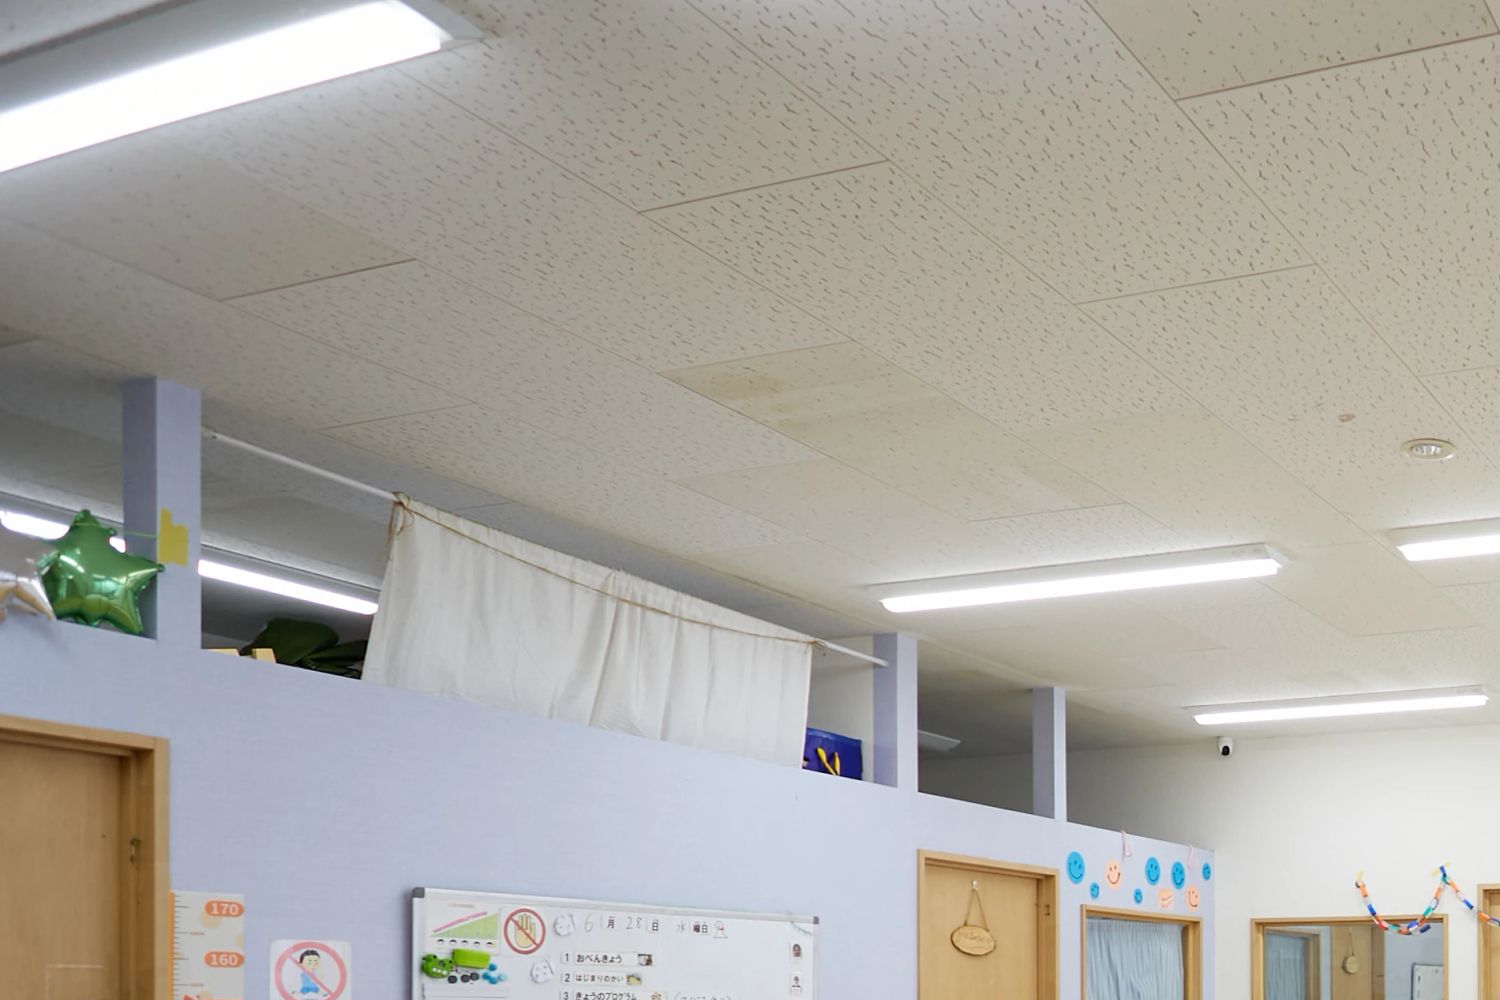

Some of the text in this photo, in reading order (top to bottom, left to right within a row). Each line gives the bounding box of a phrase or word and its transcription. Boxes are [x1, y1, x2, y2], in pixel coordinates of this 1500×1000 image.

[210, 902, 238, 916] 170
[210, 953, 238, 966] 160
[576, 953, 623, 964] おべんきょう
[576, 974, 624, 983] はじまりのかい
[575, 991, 637, 1000] きょうのプログラム
